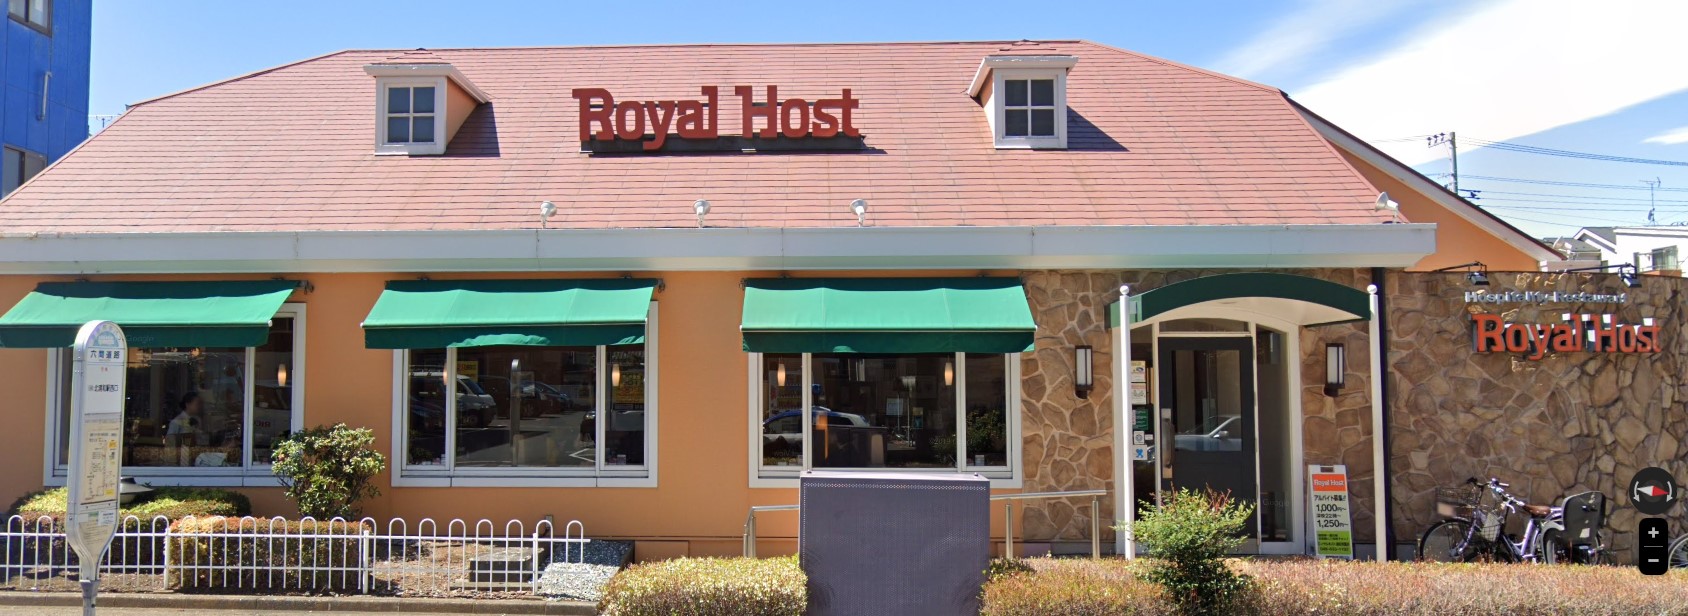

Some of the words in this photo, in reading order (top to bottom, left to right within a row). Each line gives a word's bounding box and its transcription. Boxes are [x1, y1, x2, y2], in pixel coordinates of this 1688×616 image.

[572, 85, 718, 151] Royal
[735, 85, 859, 138] Host
[1471, 313, 1583, 361] Royal
[1591, 313, 1662, 353] Host
